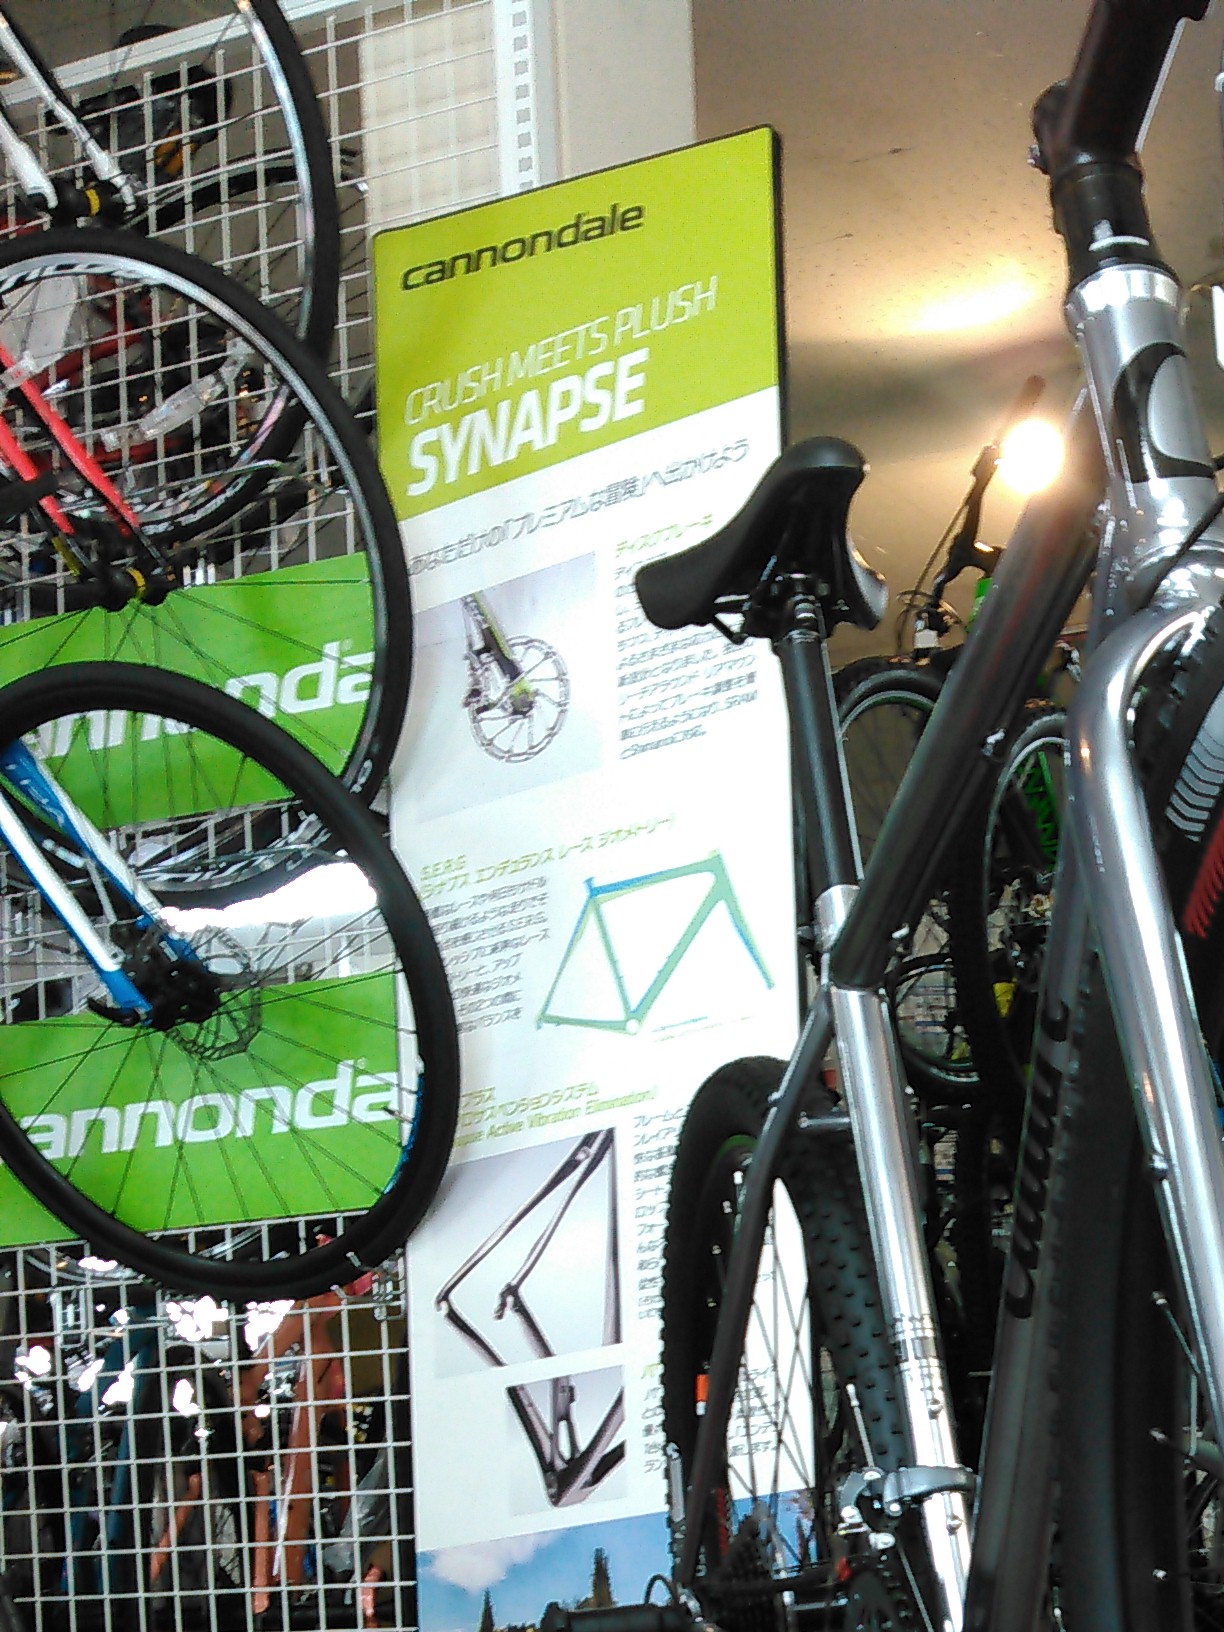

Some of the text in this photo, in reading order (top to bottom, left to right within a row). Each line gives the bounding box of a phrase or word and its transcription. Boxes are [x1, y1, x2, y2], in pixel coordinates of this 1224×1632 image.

[401, 202, 645, 291] cannondale
[404, 274, 718, 426] CRUSH MEETS PLUSH
[405, 346, 650, 497] SYNAPSE
